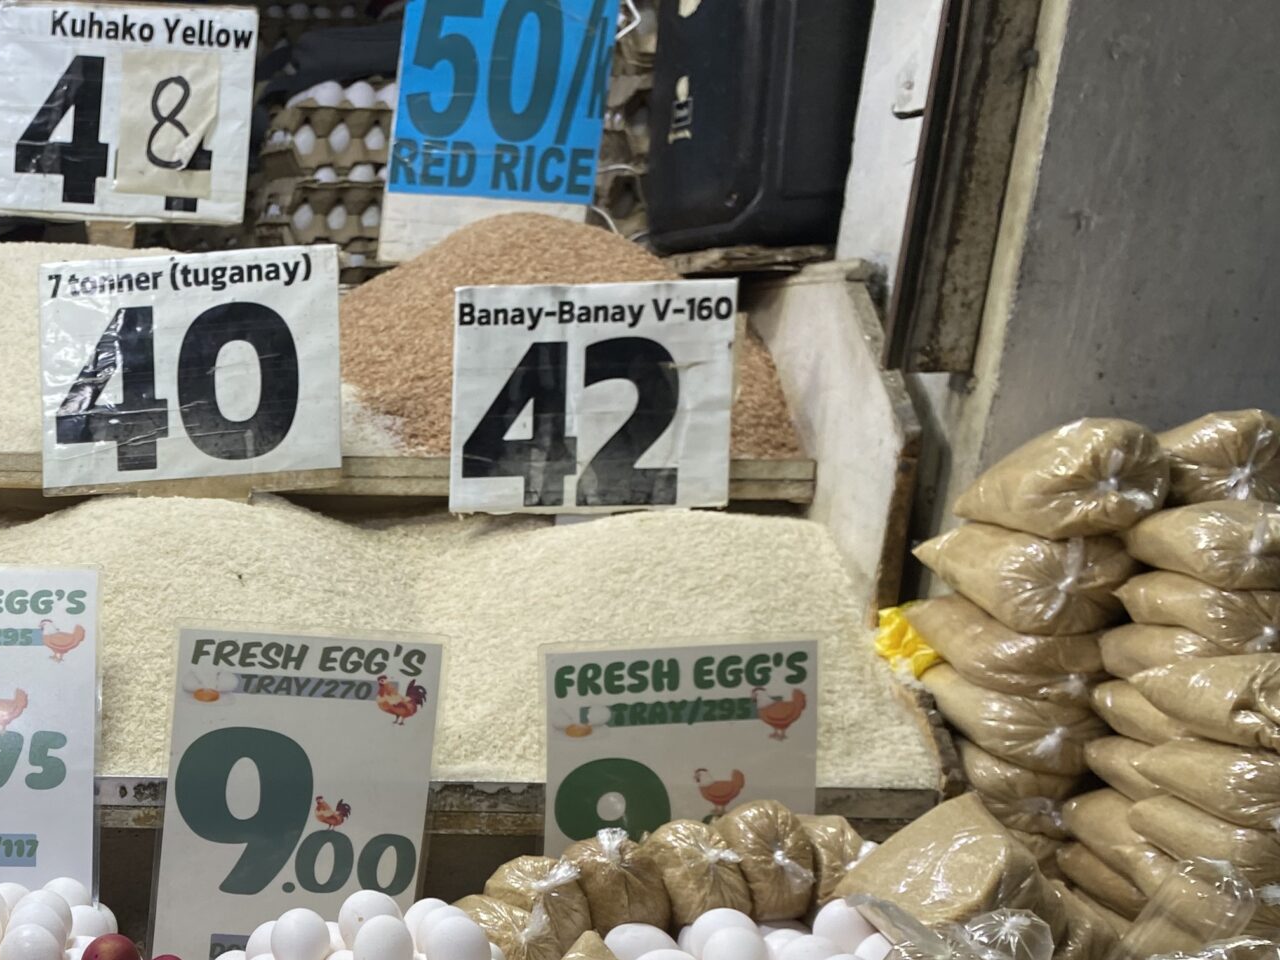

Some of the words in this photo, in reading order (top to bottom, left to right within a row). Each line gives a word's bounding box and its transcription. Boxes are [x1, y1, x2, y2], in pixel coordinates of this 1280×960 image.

[50, 10, 154, 42] Kuhako
[164, 18, 253, 50] Yellow
[389, 138, 476, 187] RED
[491, 143, 595, 196] RICE
[48, 274, 62, 298] 7
[68, 270, 163, 297] tonner
[170, 253, 312, 290] (tuganay)
[458, 301, 645, 330] Banay-Banay
[653, 296, 733, 322] V-160
[56, 301, 299, 472] 40
[461, 336, 680, 507] 42
[191, 638, 309, 671] FRESH
[318, 644, 427, 677] EGG'S
[554, 658, 680, 699] FRESH
[693, 651, 808, 689] EGG'S
[240, 674, 371, 700] TRAY/270
[175, 726, 417, 896] 9.00
